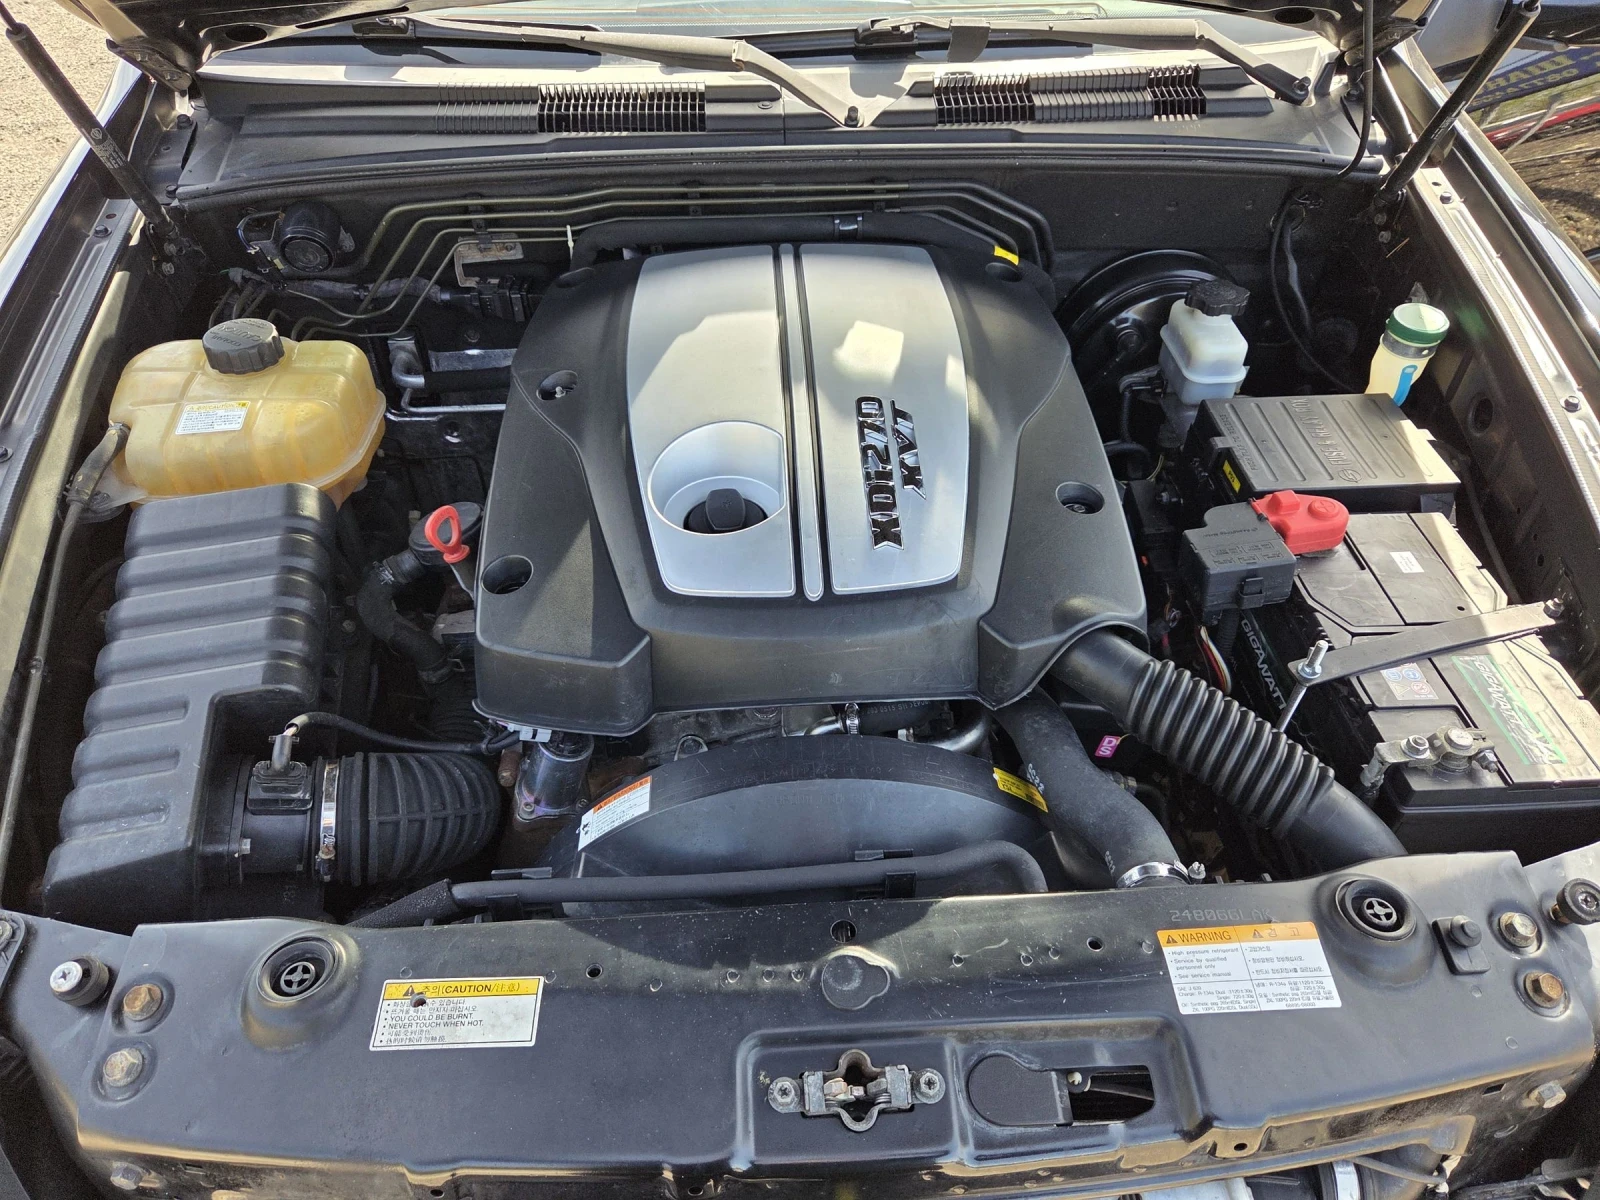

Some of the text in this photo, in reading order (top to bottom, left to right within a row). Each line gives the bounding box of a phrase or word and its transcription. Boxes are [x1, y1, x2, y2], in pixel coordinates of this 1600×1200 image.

[1241, 620, 1287, 709] GIGAWATT
[1474, 661, 1527, 728] GIGAWATT
[1178, 930, 1232, 943] WARNING
[388, 1022, 414, 1030] NEVER
[443, 1020, 466, 1028] WHEN
[467, 1019, 484, 1027] HOT.
[407, 1014, 434, 1022] COULD
